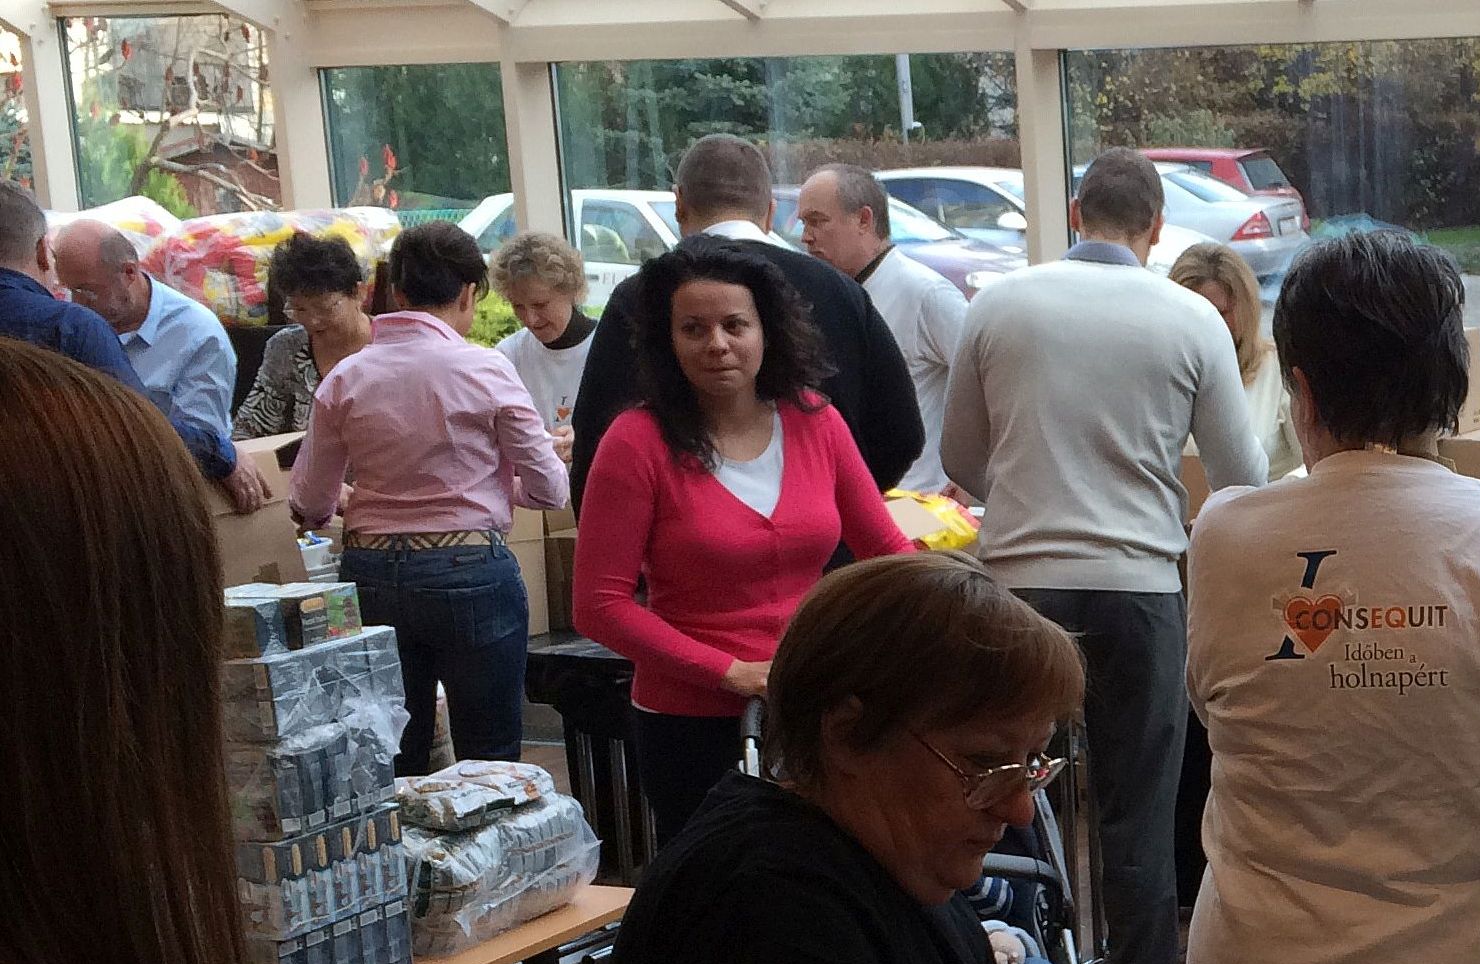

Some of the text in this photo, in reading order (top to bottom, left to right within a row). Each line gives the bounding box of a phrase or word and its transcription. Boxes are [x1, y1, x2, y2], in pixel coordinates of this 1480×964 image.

[1296, 605, 1448, 631] CONSEQUIT
[1344, 643, 1417, 664] Időben a
[1329, 664, 1449, 695] holnapért
